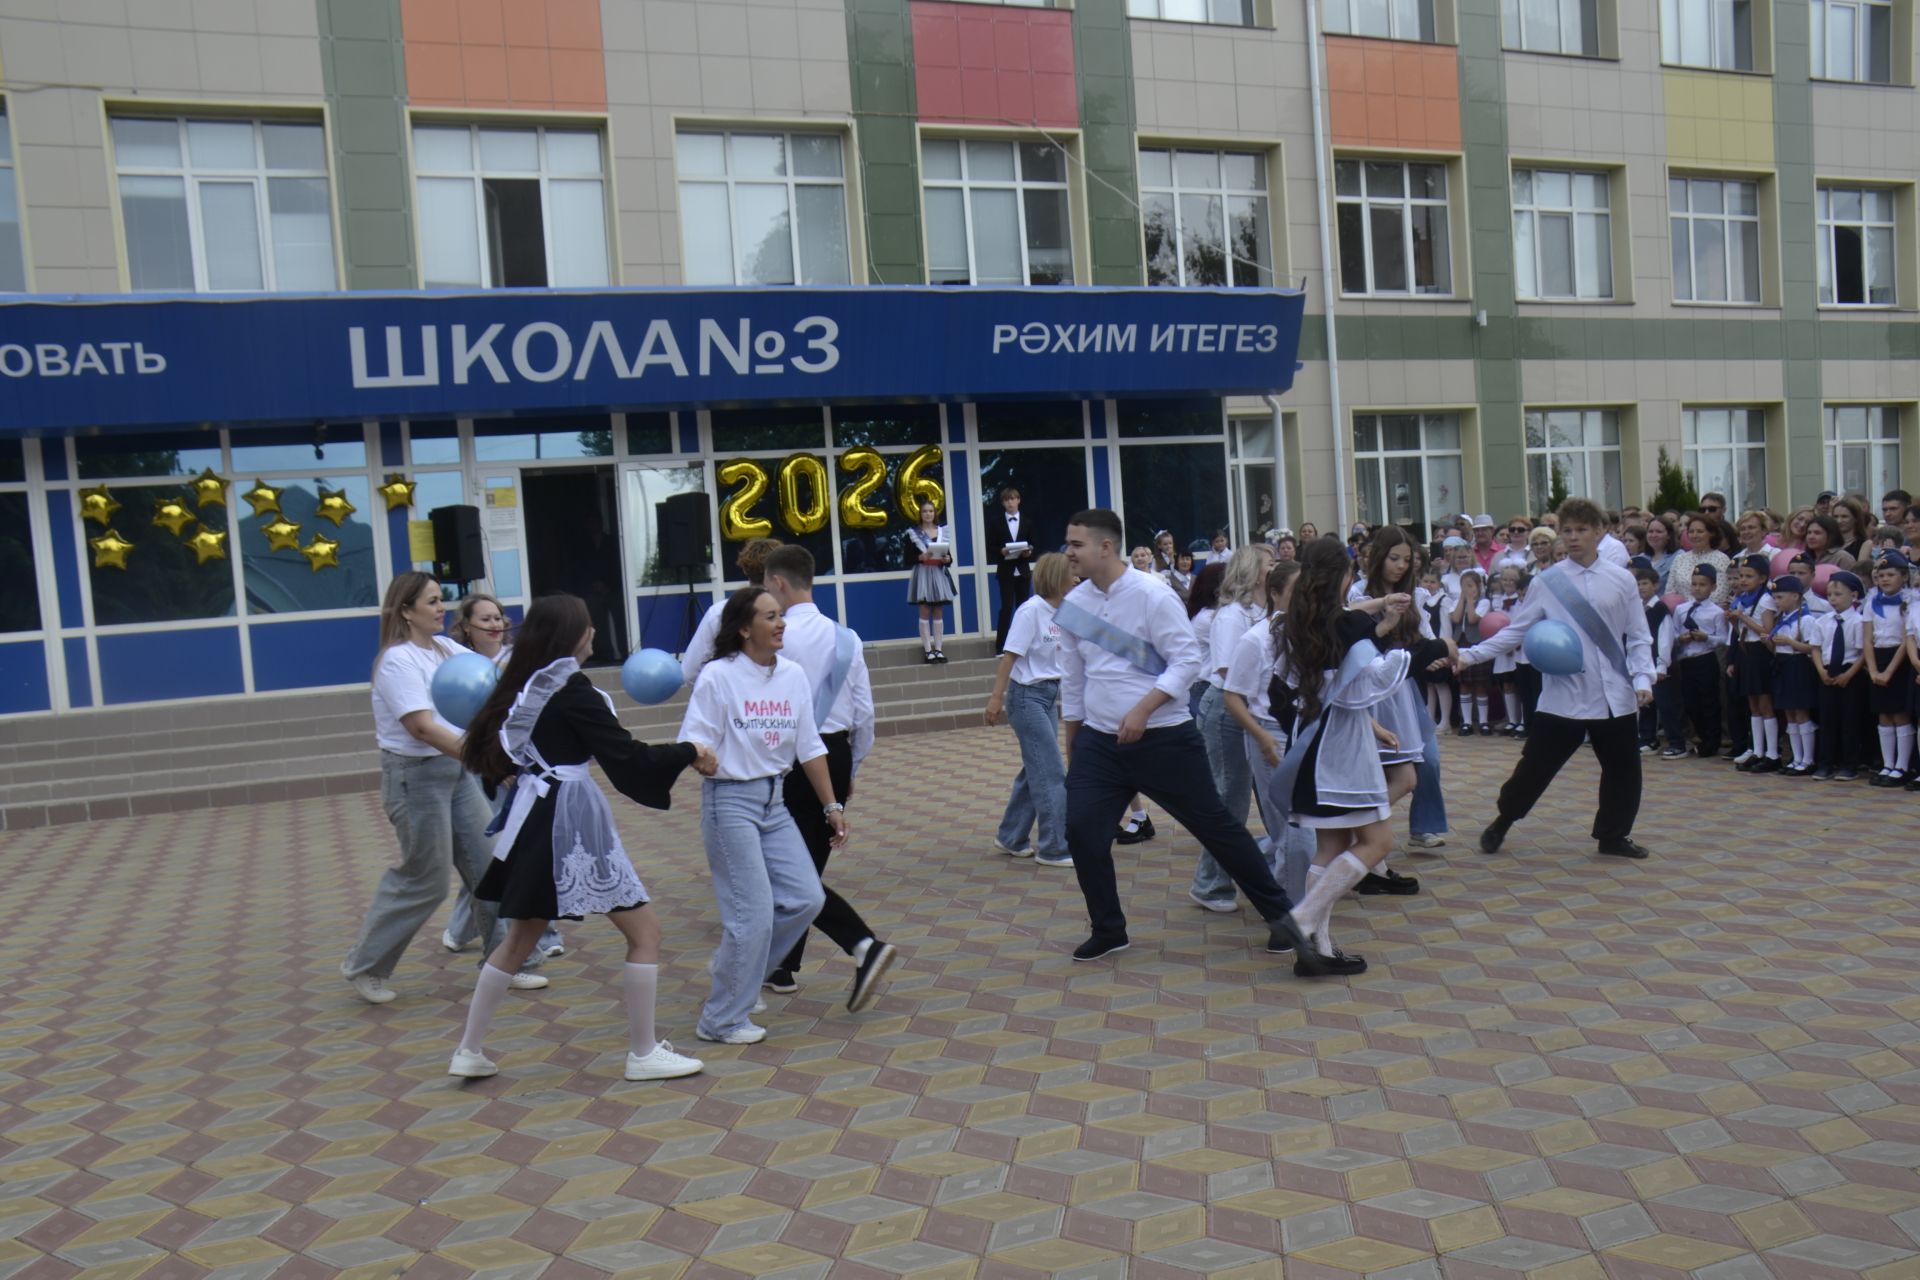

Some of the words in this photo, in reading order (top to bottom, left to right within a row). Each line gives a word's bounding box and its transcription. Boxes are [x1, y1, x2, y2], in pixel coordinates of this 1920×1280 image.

[993, 321, 1137, 354] РӘХИМ
[1150, 323, 1279, 353] ИТЕГЕЗ
[717, 443, 945, 541] 2026
[744, 699, 793, 717] МАМА
[764, 731, 780, 746] 9А
